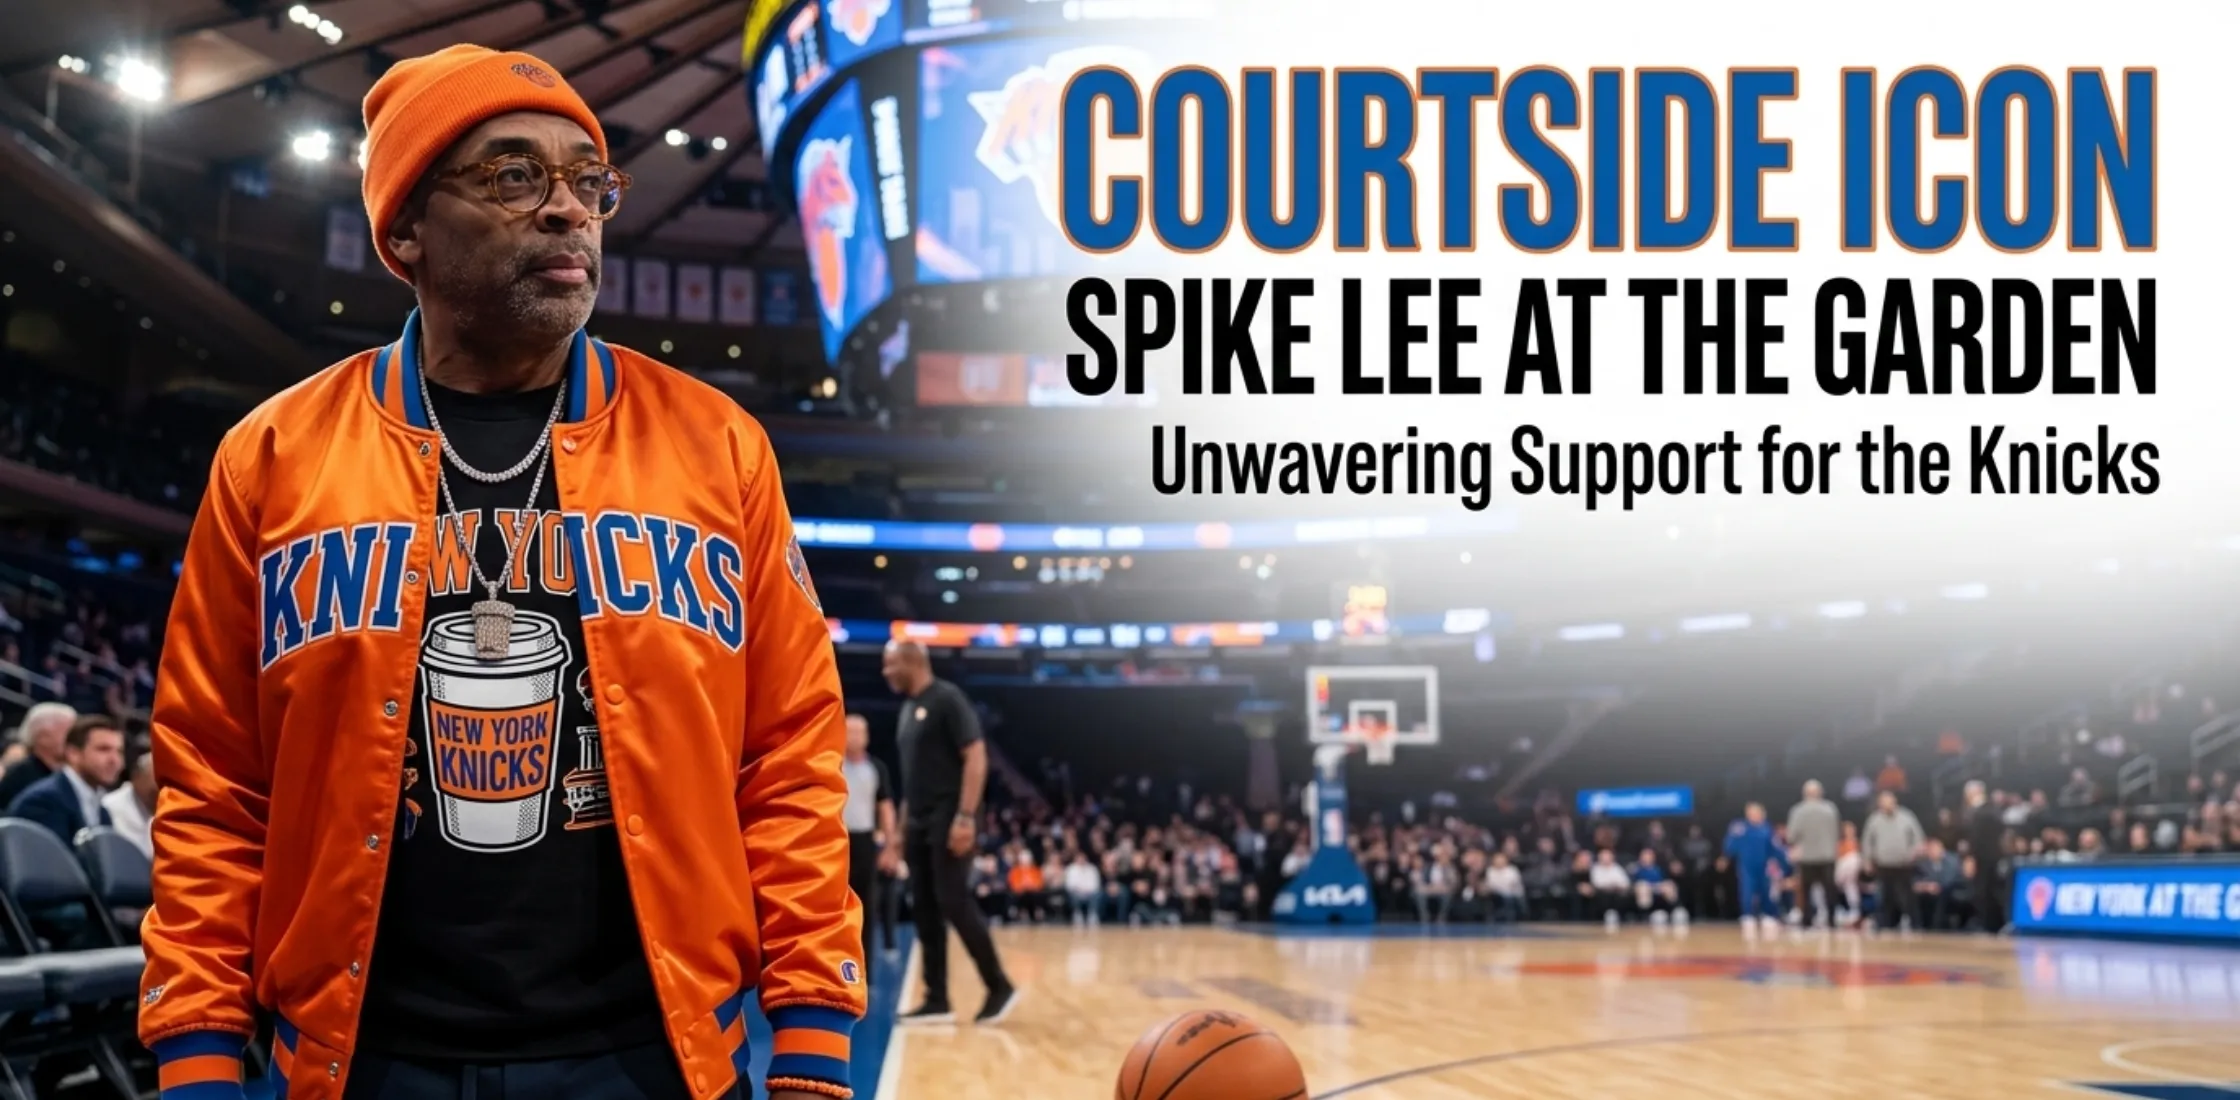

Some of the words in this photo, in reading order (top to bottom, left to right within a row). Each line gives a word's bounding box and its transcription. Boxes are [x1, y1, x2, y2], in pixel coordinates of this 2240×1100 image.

[495, 508, 579, 596] YO
[260, 522, 417, 672] KNI
[562, 510, 745, 653] ICKS
[436, 711, 484, 745] NEW
[491, 711, 548, 745] YORK
[440, 744, 545, 792] KNICKS
[2148, 883, 2179, 918] AT
[2180, 883, 2223, 920] THE
